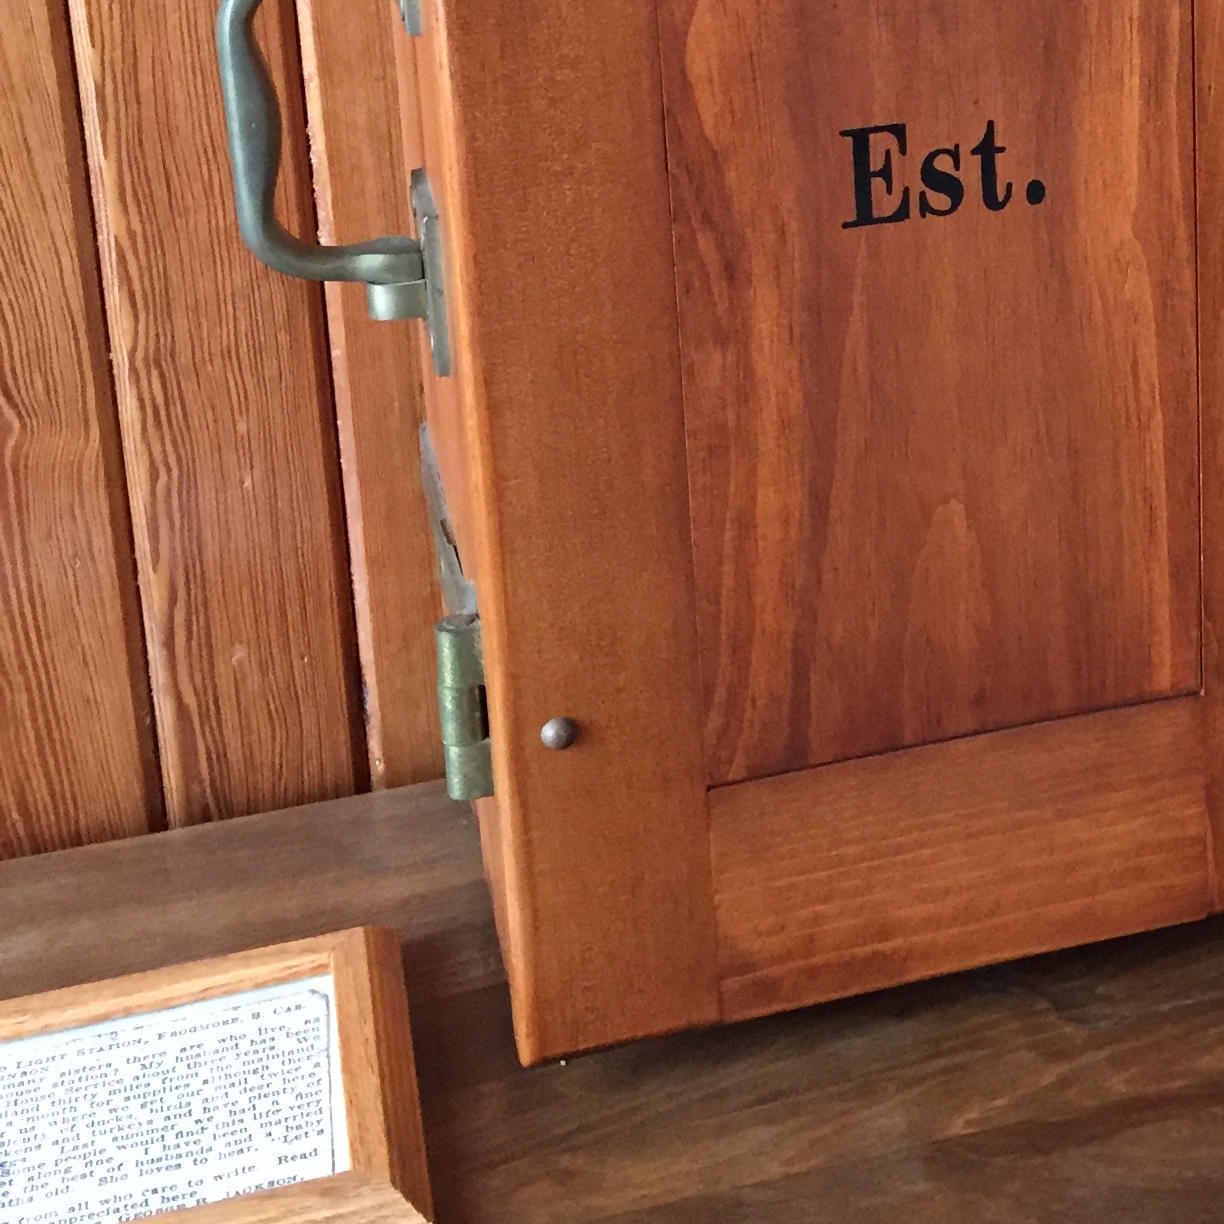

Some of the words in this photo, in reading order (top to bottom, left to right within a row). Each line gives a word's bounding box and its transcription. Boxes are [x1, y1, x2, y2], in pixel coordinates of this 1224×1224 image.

[839, 120, 1046, 229] Est.
[3, 1078, 44, 1089] many
[59, 1063, 112, 1078] sisters
[126, 1052, 166, 1064] there
[180, 1043, 204, 1053] are
[217, 1034, 246, 1043] who
[52, 1067, 119, 1088] station?
[250, 1037, 275, 1046] has
[286, 1027, 319, 1038] been
[51, 1093, 97, 1107] thirty
[108, 1083, 150, 1096] miles
[161, 1072, 198, 1084] from
[89, 1100, 113, 1108] for
[124, 1083, 190, 1102] supplies
[177, 1089, 203, 1099] our
[229, 1103, 256, 1117] had
[0, 1144, 41, 1157] kens
[52, 1133, 80, 1146] and
[164, 1109, 192, 1122] and
[203, 1100, 238, 1114] have
[248, 1087, 298, 1104] plenty
[27, 1166, 72, 1182] along
[162, 1139, 201, 1152] have
[213, 1128, 247, 1140] been
[260, 1107, 322, 1128] married
[54, 1149, 106, 1167] people
[116, 1134, 165, 1150] would
[215, 1119, 244, 1130] this
[289, 1099, 322, 1111] very
[23, 1183, 48, 1193] the
[135, 1146, 212, 1167] husbands
[225, 1134, 252, 1147] and
[285, 1118, 323, 1132] baby
[139, 1163, 181, 1176] loves
[19, 1211, 58, 1224] from
[68, 1201, 88, 1213] all
[99, 1194, 132, 1205] who
[142, 1185, 177, 1196] care
